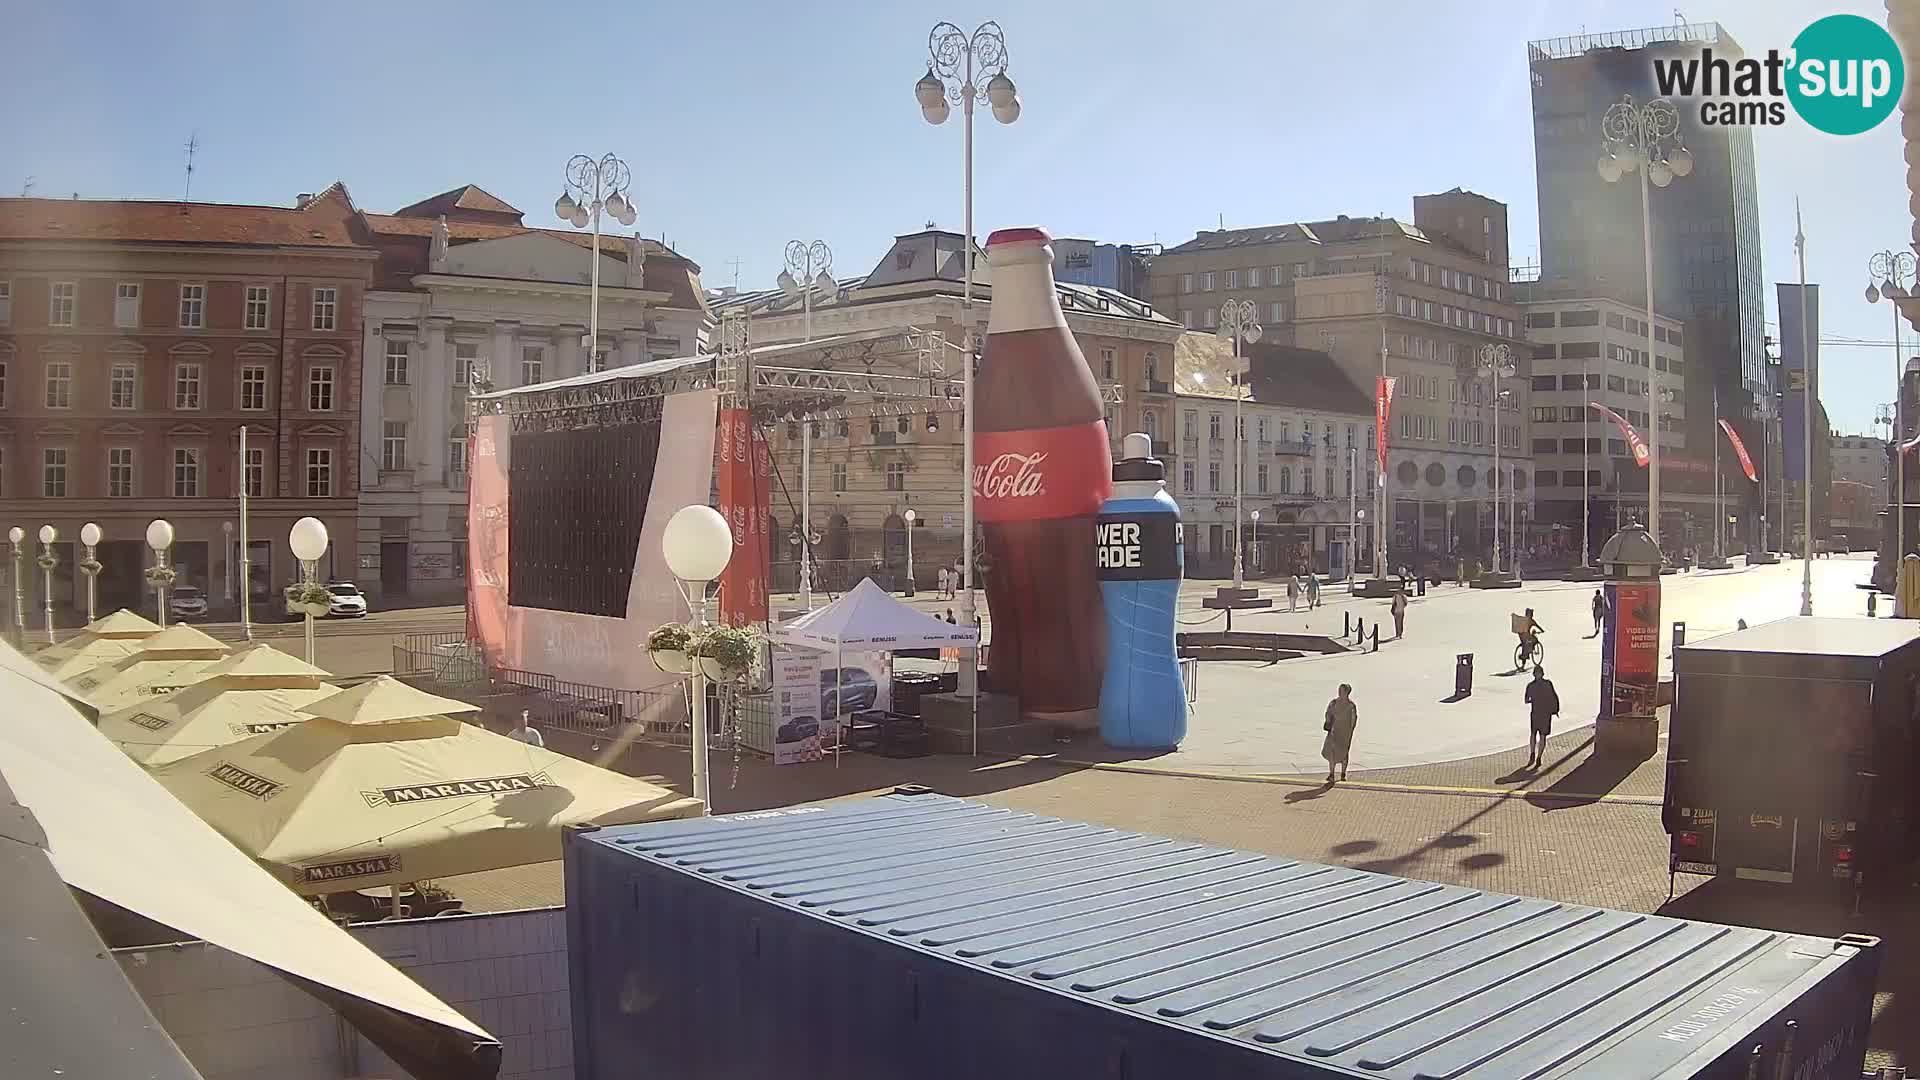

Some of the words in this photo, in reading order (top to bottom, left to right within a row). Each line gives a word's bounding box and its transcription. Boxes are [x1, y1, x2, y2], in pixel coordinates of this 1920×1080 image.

[720, 421, 730, 463] Coca-Cola
[734, 421, 746, 462] Coca-Cola
[733, 504, 745, 546] Coca-Cola
[1095, 522, 1141, 545] WER
[393, 777, 531, 802] MARASKA
[309, 860, 387, 881] MARASKA
